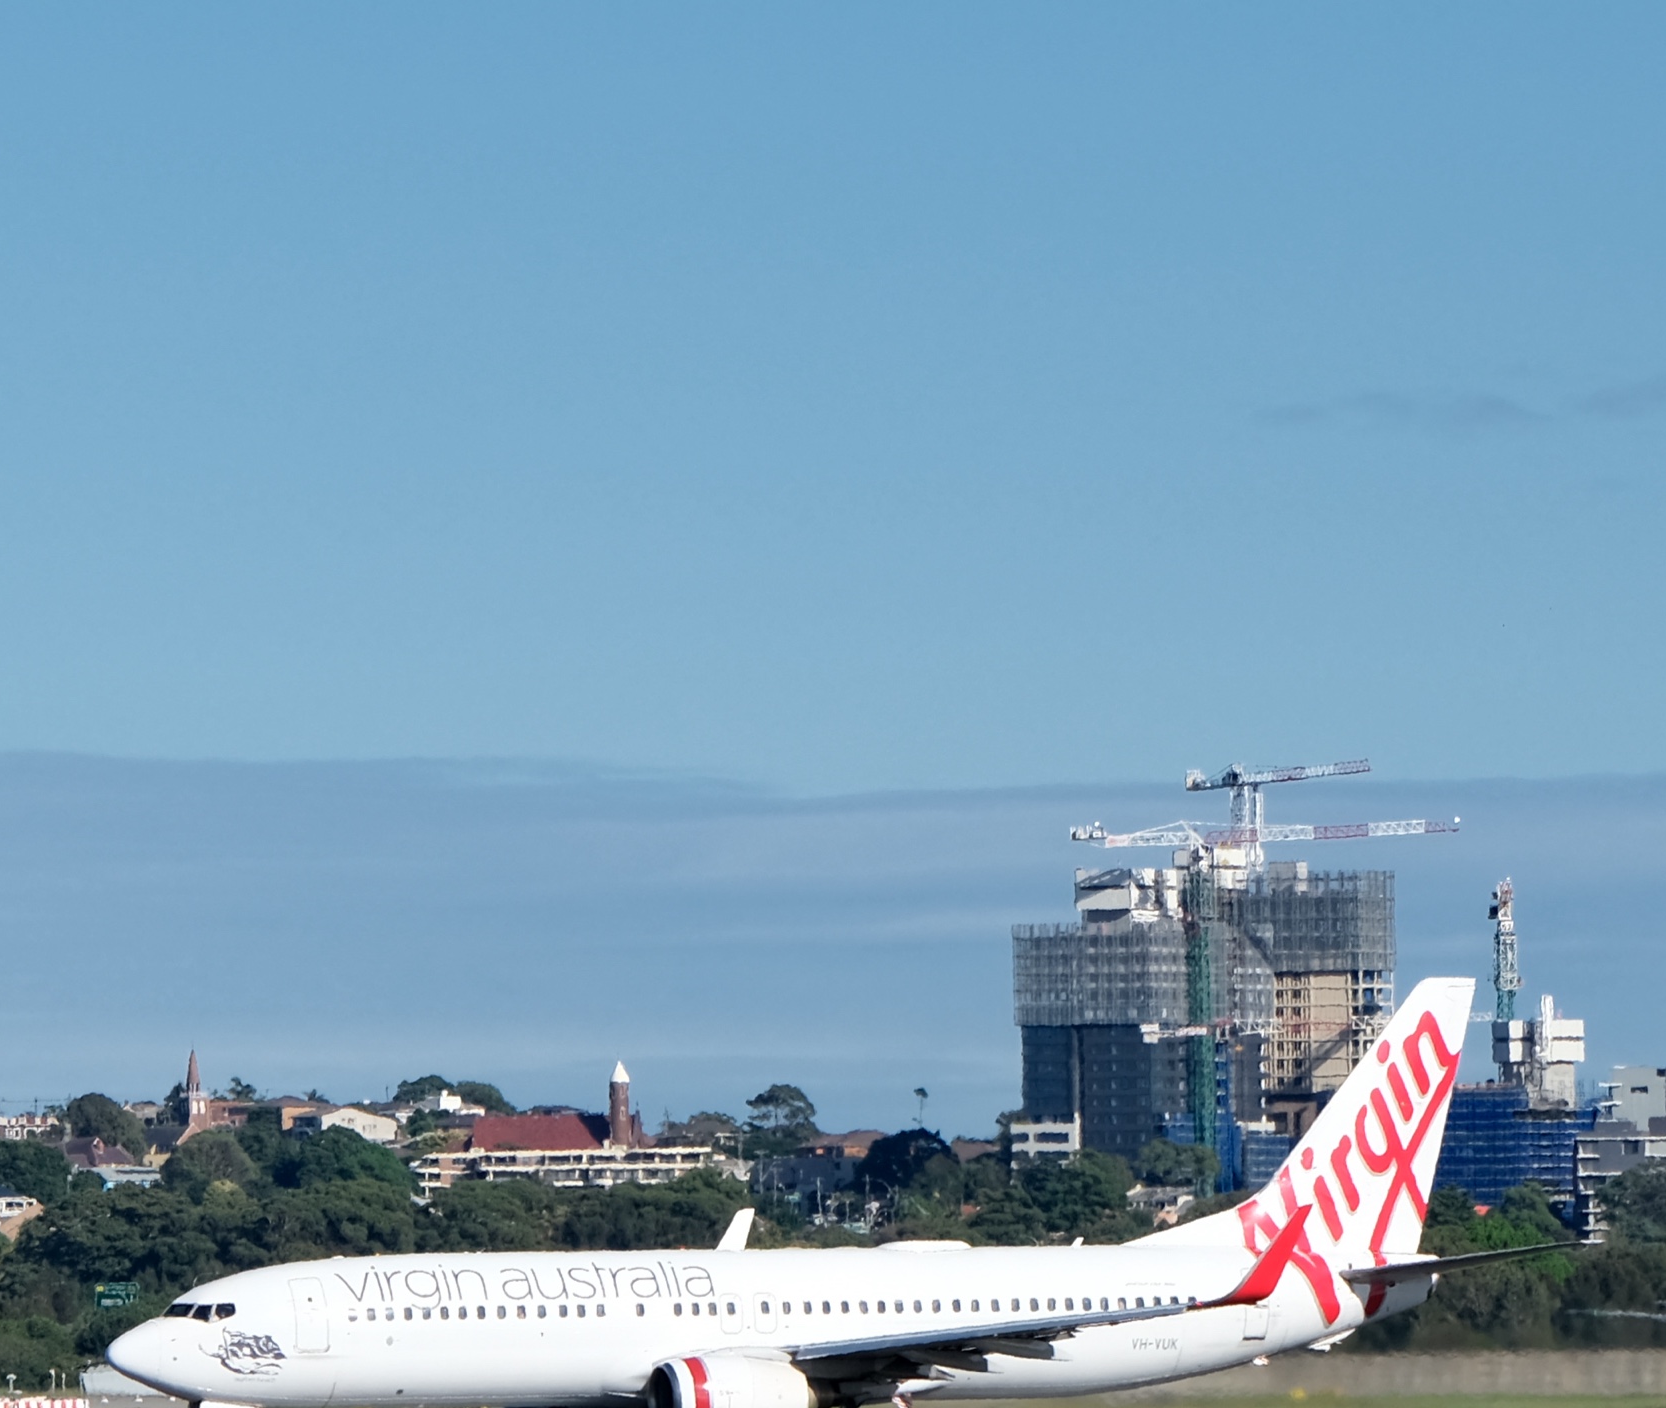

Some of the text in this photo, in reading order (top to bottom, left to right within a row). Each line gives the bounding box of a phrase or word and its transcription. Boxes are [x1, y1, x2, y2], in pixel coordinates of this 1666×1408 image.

[334, 1261, 715, 1310] virgin australia
[1131, 1338, 1179, 1351] VH-VUK
